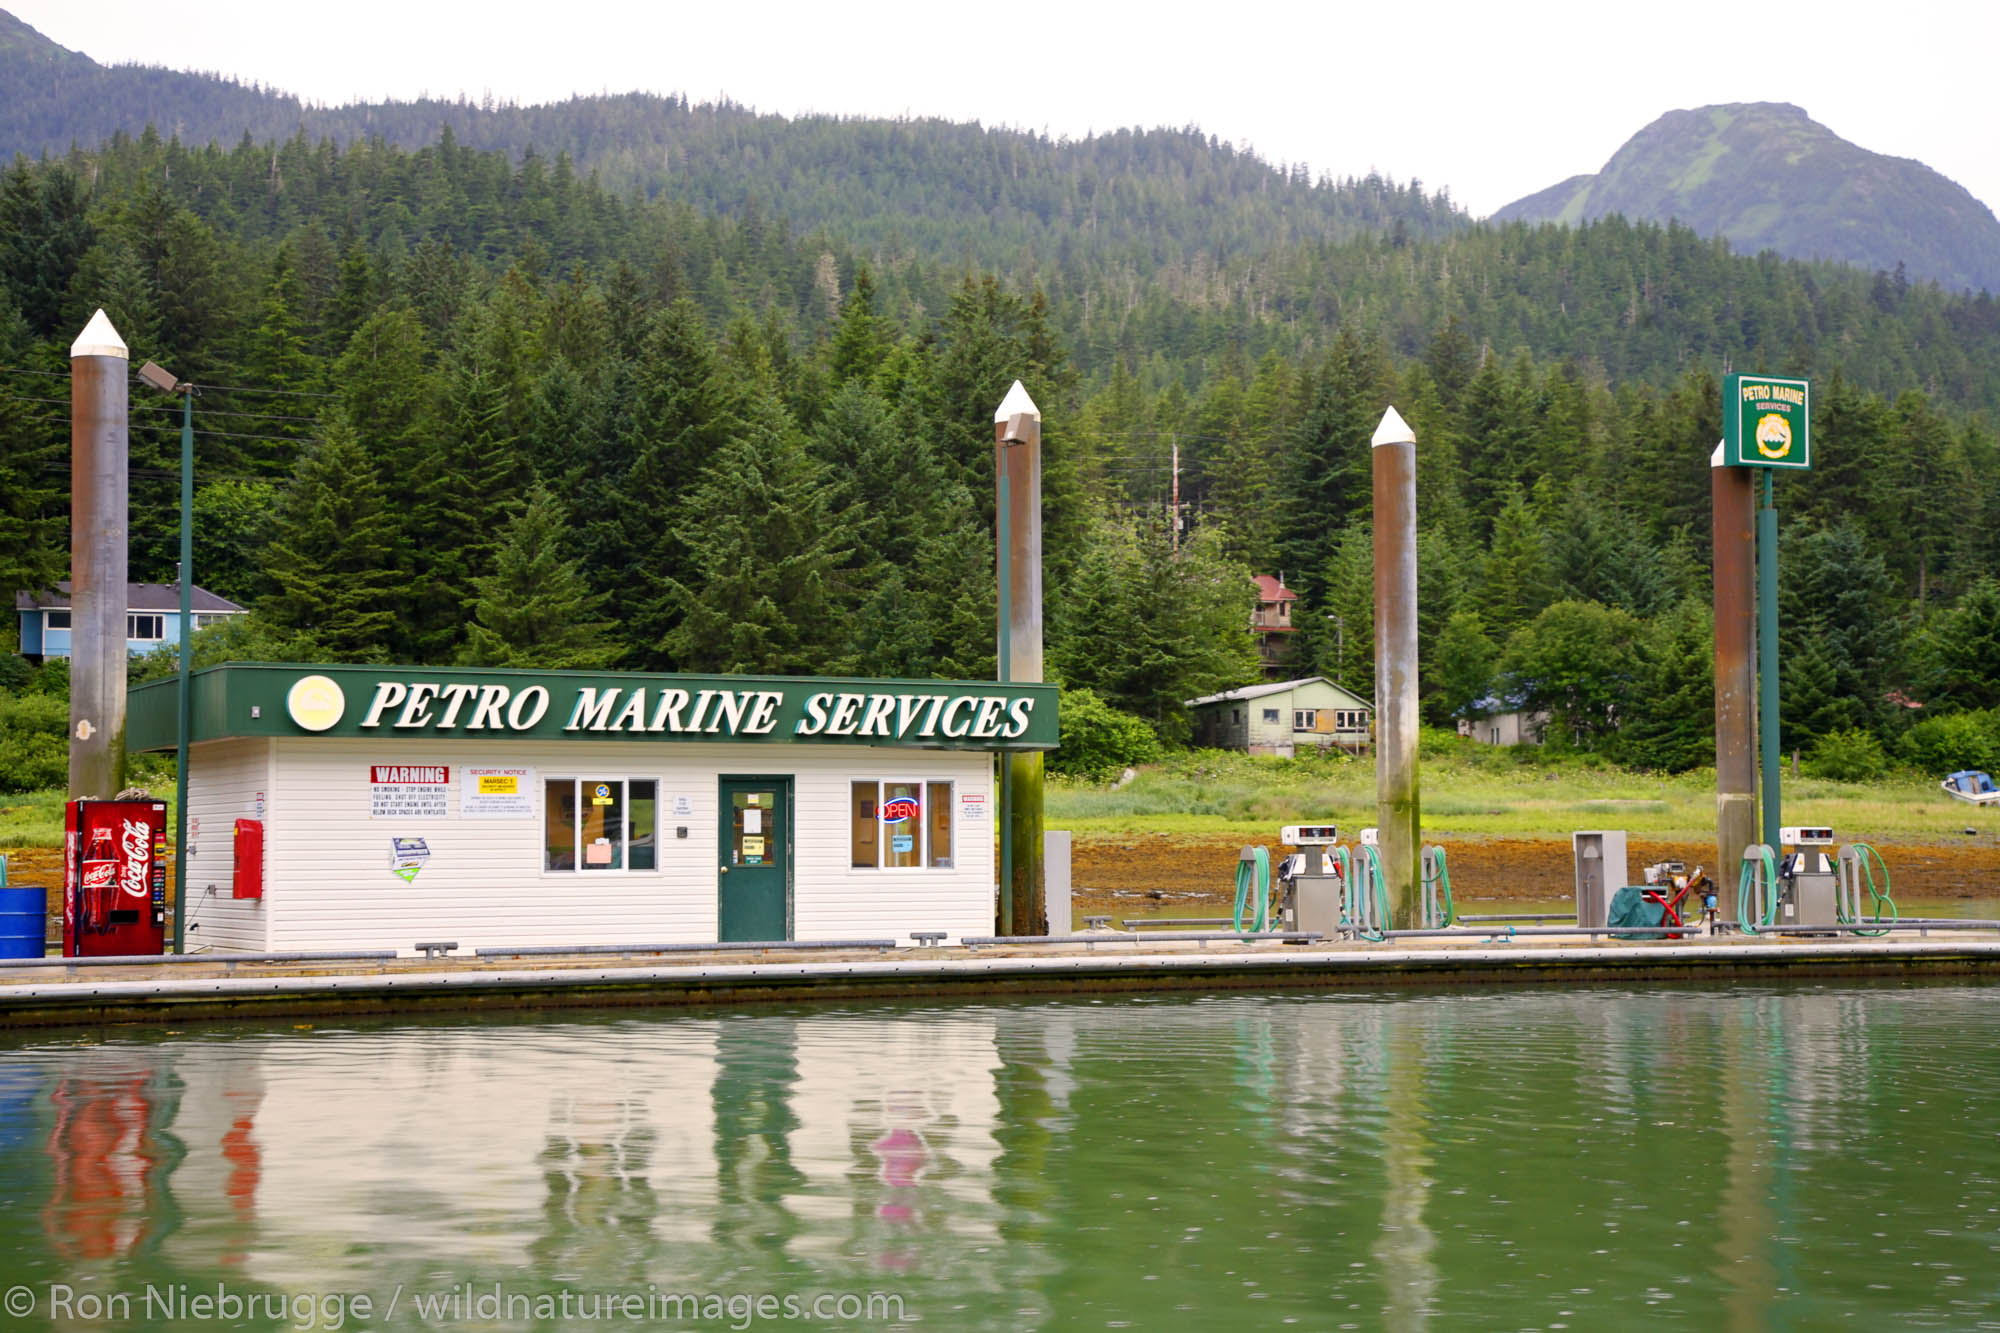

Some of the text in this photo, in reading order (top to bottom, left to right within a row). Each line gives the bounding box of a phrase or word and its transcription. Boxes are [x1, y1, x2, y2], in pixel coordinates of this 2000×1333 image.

[1742, 385, 1804, 406] PETRO MARINE
[1756, 402, 1791, 412] SERVICES
[359, 682, 1035, 739] PETRO MARINE SERVICES
[376, 767, 445, 782] WARNING
[876, 803, 918, 818] OPEN
[120, 818, 150, 898] Coca-Cola
